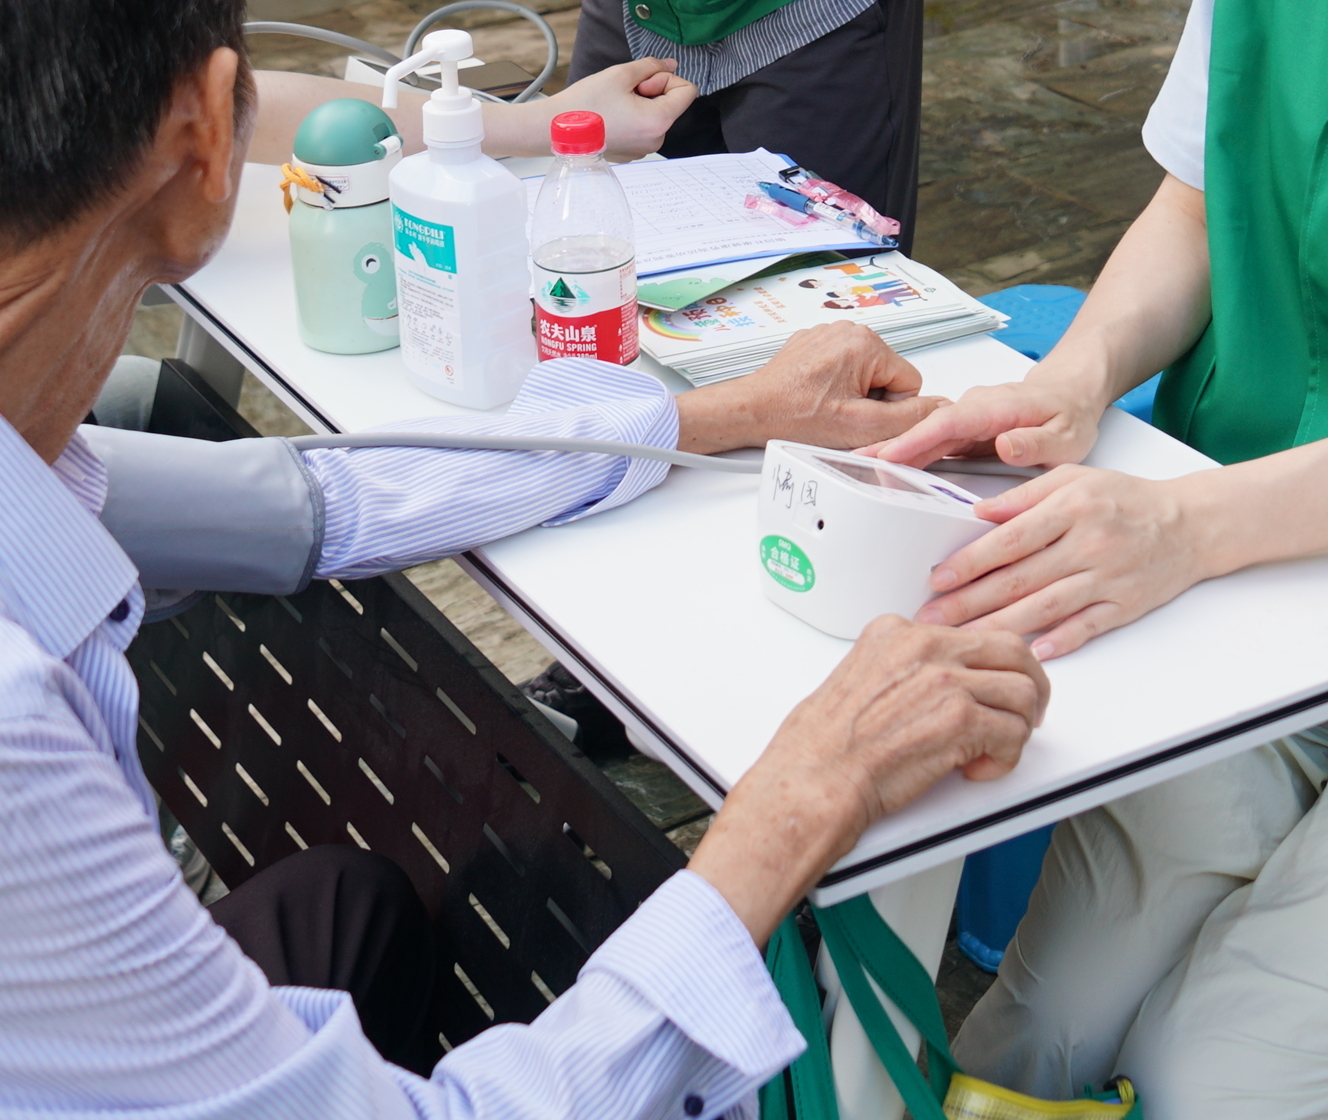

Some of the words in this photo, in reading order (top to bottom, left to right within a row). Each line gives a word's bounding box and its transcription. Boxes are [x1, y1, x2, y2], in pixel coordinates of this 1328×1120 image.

[540, 319, 597, 342] 农夫山泉
[567, 343, 597, 352] SPRING
[770, 545, 800, 570] 合格证
